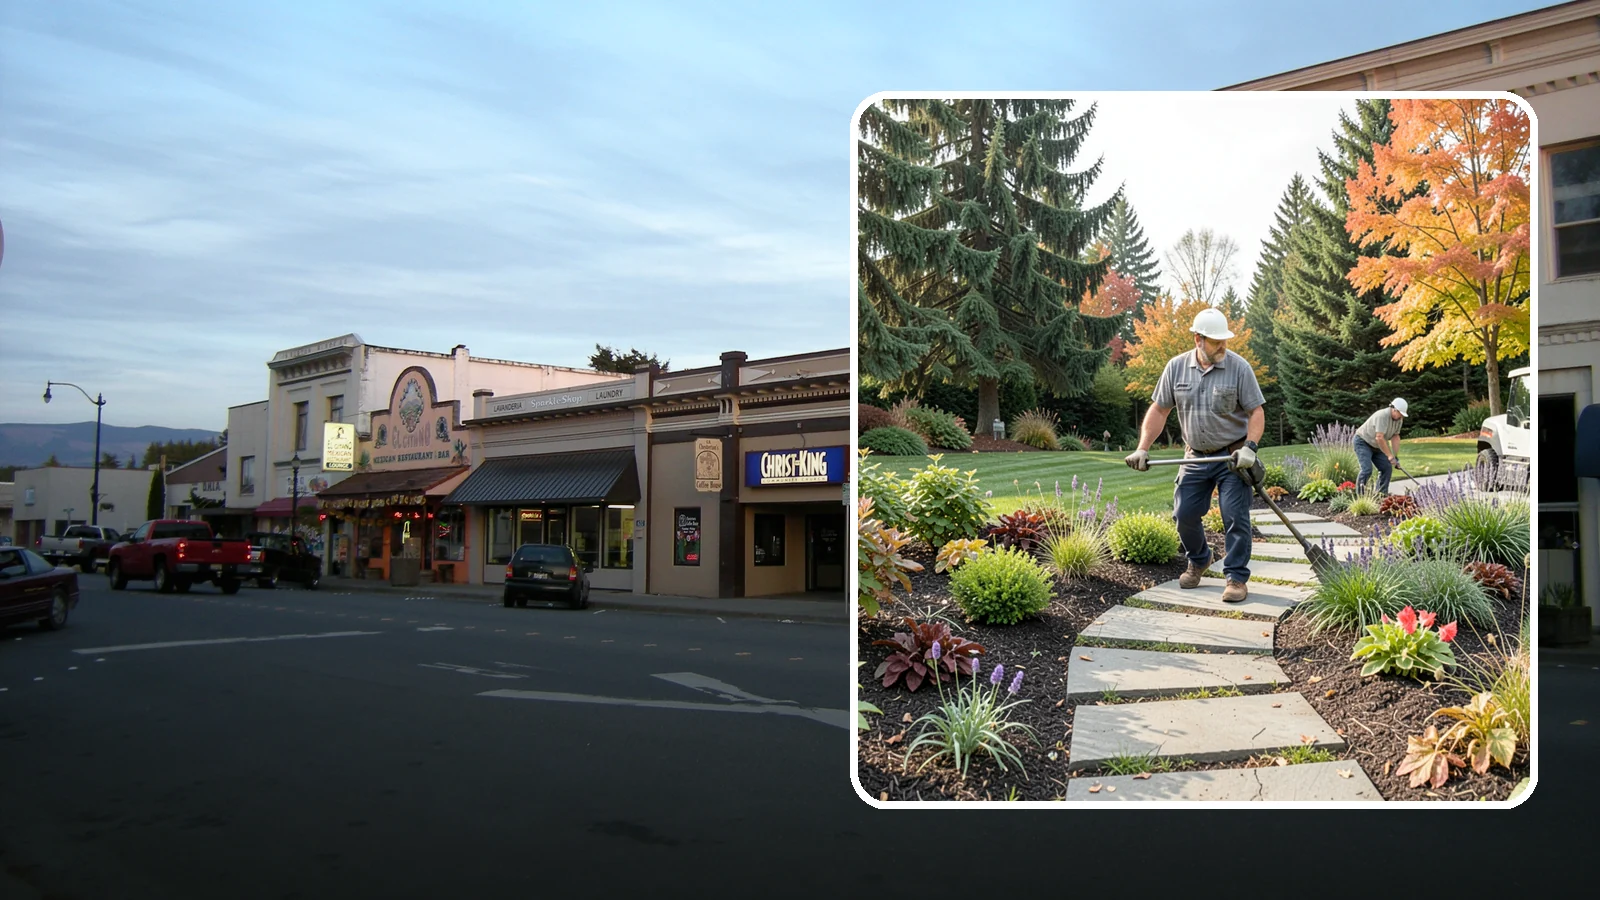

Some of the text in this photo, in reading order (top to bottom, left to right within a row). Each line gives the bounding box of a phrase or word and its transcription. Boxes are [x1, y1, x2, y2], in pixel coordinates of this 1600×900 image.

[493, 402, 522, 412] LAVANDERIA
[561, 394, 583, 405] Shop
[595, 389, 624, 400] LAUNDRY
[373, 454, 396, 464] MEXICAN
[397, 451, 434, 462] RESTAURANT
[438, 450, 450, 459] BAR
[761, 450, 827, 478] CHRIST KING
